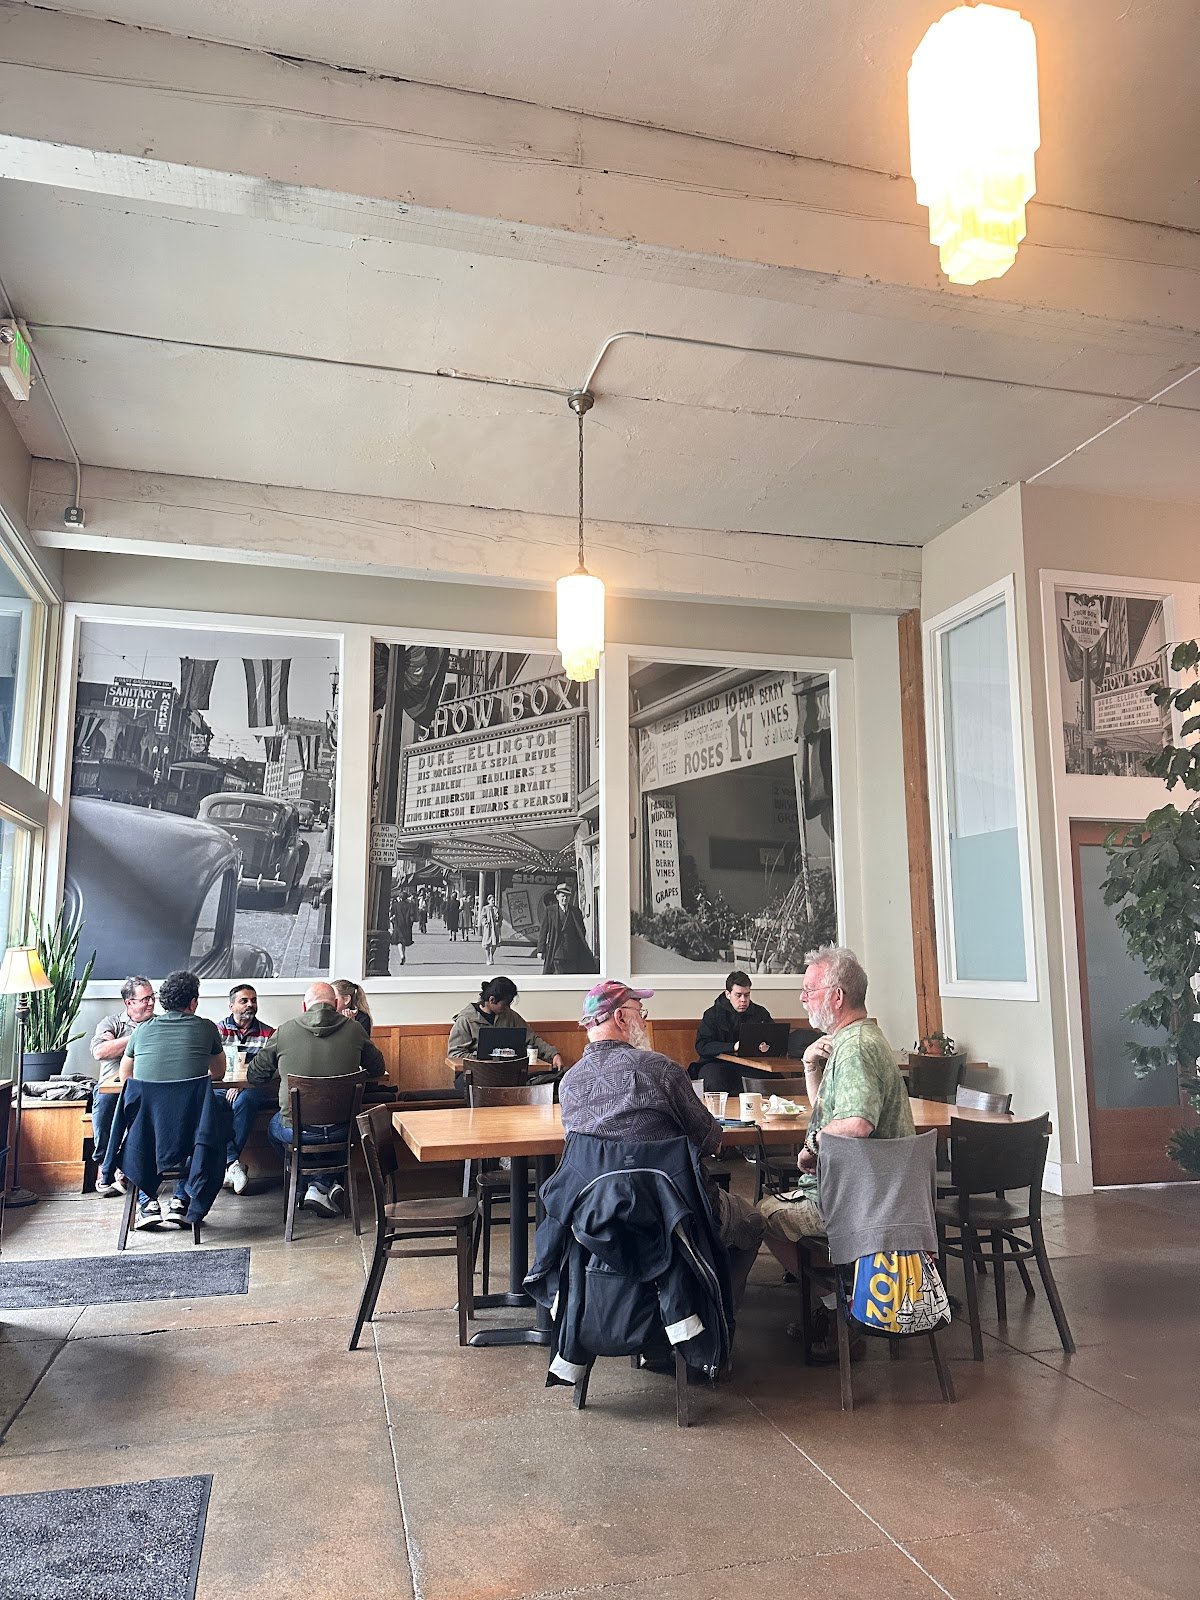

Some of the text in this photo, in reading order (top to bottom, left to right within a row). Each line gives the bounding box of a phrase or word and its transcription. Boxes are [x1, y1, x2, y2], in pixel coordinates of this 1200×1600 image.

[1133, 665, 1157, 684] BOX
[109, 686, 158, 700] SANITARY
[112, 696, 153, 709] PUBLIC
[725, 684, 756, 715] 10 FOR
[760, 679, 785, 706] BERRY
[158, 692, 171, 731] MARKET
[418, 676, 573, 742] SHOW BOX
[690, 703, 706, 720] YEAR
[707, 698, 720, 713] OLD
[760, 704, 789, 728] VINES
[418, 730, 557, 770] DUKE ELLINGTON
[684, 742, 724, 775] ROSES
[418, 770, 430, 781] HIS
[433, 763, 478, 777] ORCHESTRA
[490, 754, 518, 768] SEPIA
[524, 748, 557, 762] REVUE
[416, 763, 556, 795] 25 HARLEM HEADLINERS 25
[416, 779, 552, 808] IVIE ANDERSON MARIE BRYANT
[406, 812, 423, 823] KING
[423, 807, 465, 821] DICKERSON
[470, 801, 509, 815] EDWARDS
[524, 792, 569, 808] PEARSON
[651, 811, 675, 824] NURSERY
[655, 829, 672, 837] FRUIT
[655, 840, 673, 848] TREES
[655, 859, 675, 868] BERRY
[655, 869, 675, 877] VINES
[512, 873, 558, 885] SHOW
[655, 887, 679, 904] GRAPES
